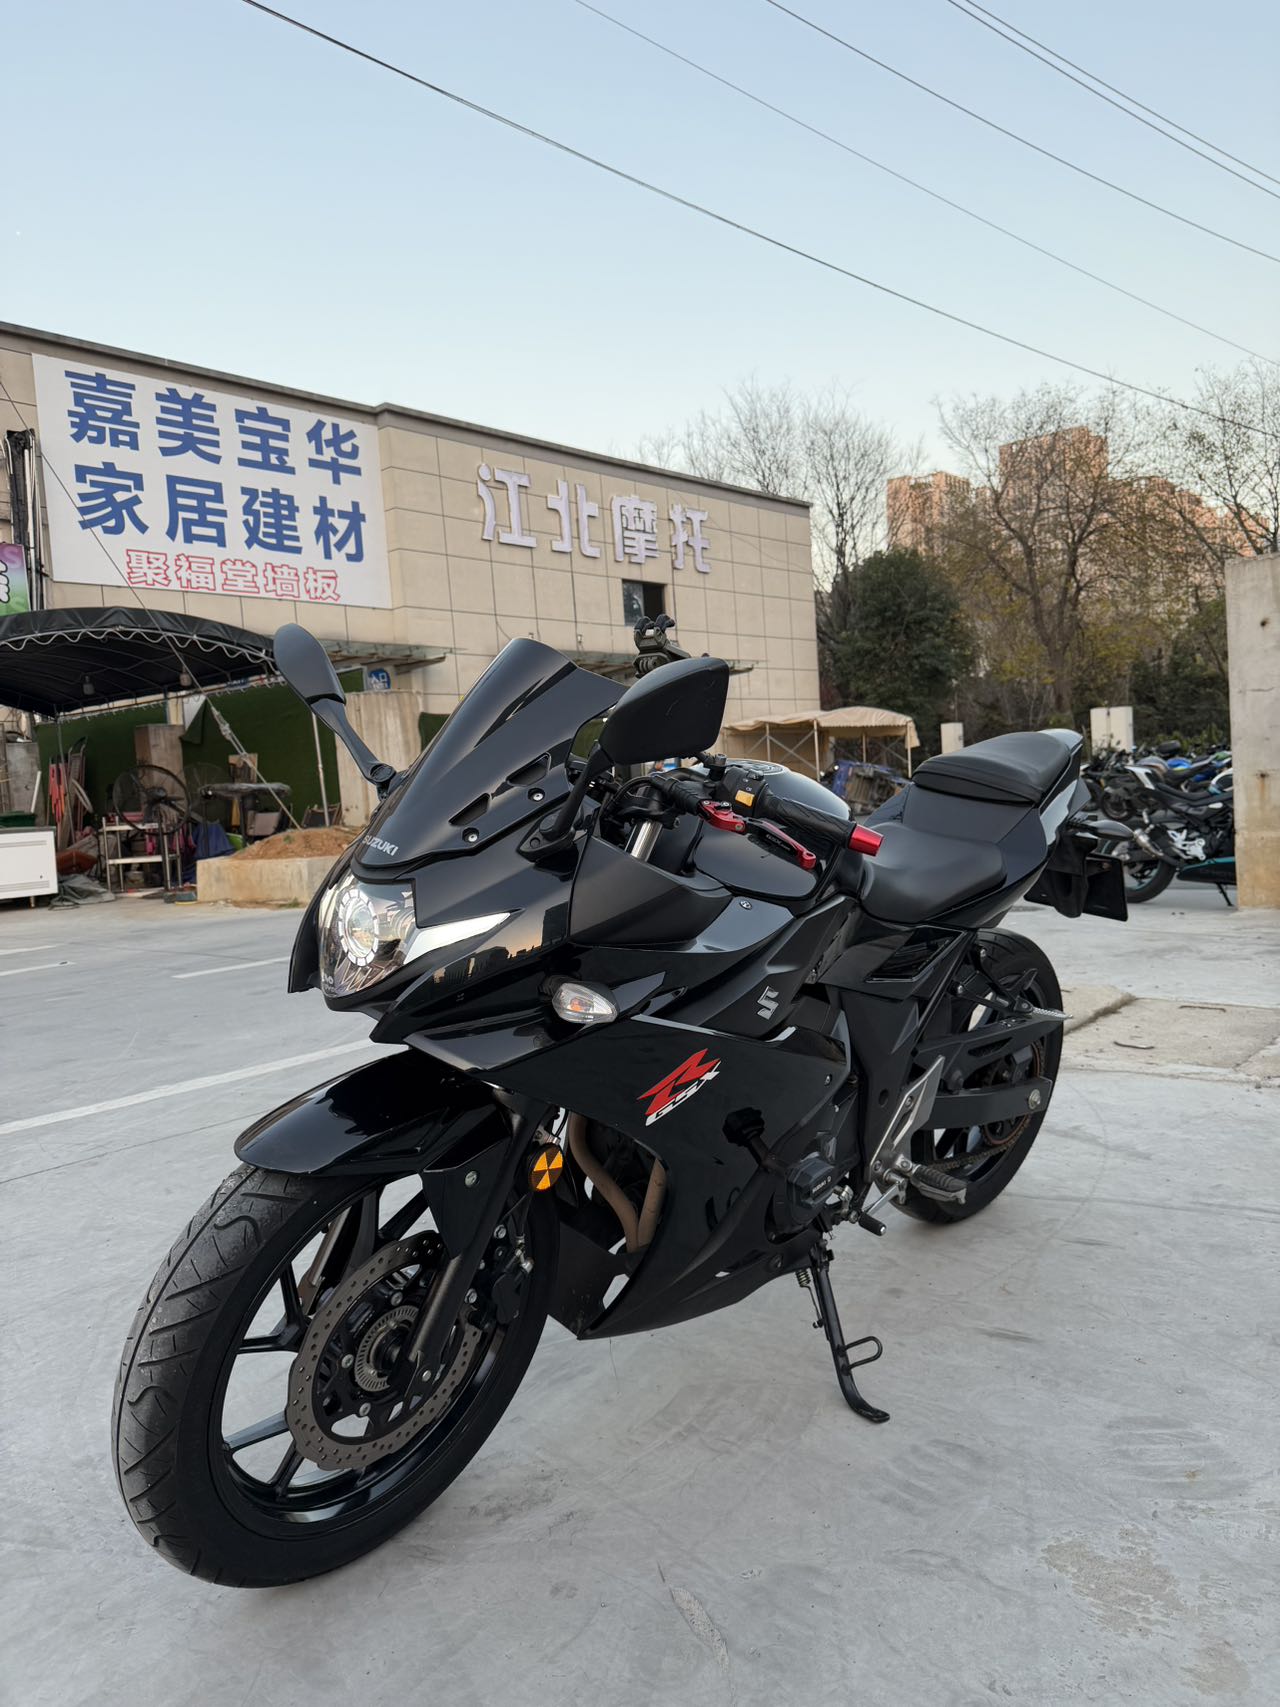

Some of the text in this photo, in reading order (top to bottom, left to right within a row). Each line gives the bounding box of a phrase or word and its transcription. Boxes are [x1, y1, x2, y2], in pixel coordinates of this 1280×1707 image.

[65, 370, 362, 485] 嘉美宝华
[75, 462, 367, 563] 家居建材
[477, 463, 712, 573] 江北摩托
[126, 549, 341, 601] 聚福堂墙板
[362, 835, 399, 857] SUZUKI
